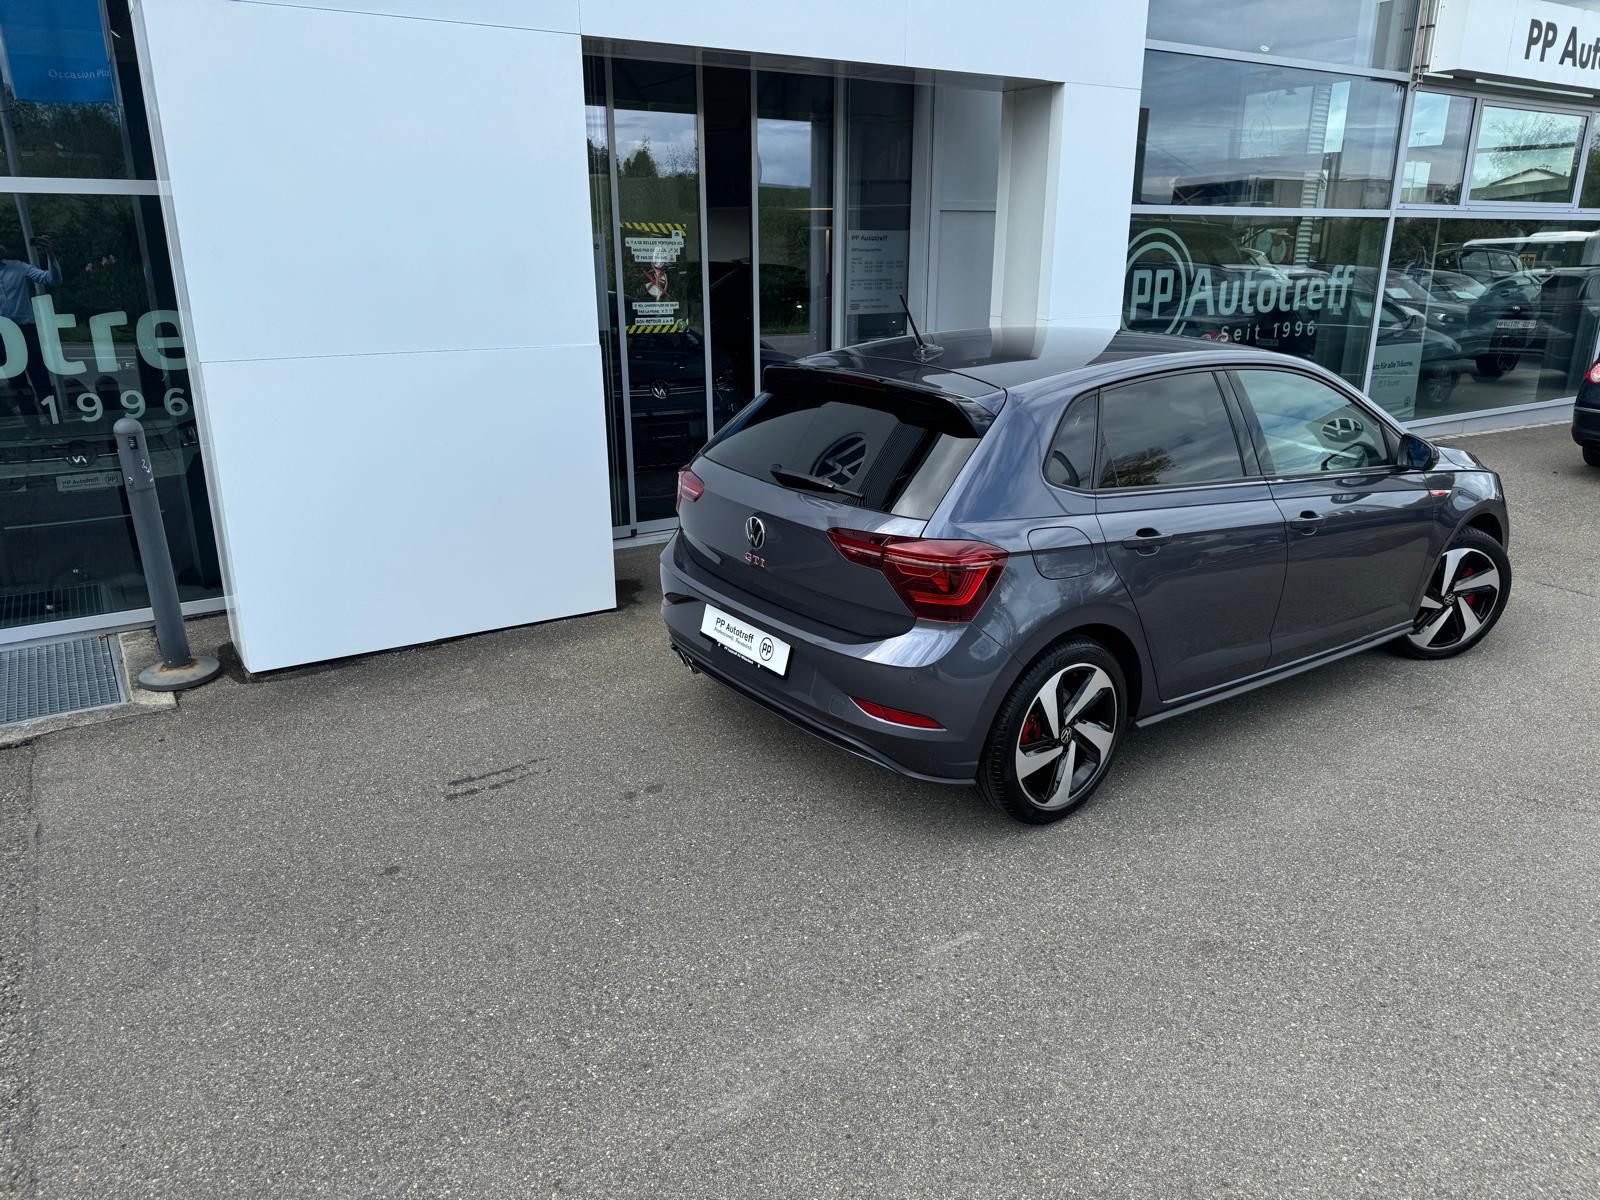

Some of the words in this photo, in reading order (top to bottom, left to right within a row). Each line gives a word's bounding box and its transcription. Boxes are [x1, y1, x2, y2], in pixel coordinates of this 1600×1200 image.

[1524, 18, 1558, 62] PP
[1558, 26, 1600, 70] Aut
[48, 69, 96, 79] Occasion
[97, 69, 110, 79] Plu
[1129, 268, 1174, 321] PP
[1184, 265, 1356, 317] Autotreff
[1220, 325, 1261, 344] Seit
[1273, 319, 1316, 339] 1996
[40, 387, 189, 424] 1996
[744, 551, 766, 568] GTI
[716, 617, 726, 628] PP
[725, 623, 755, 644] Autotreff
[761, 642, 772, 656] PP
